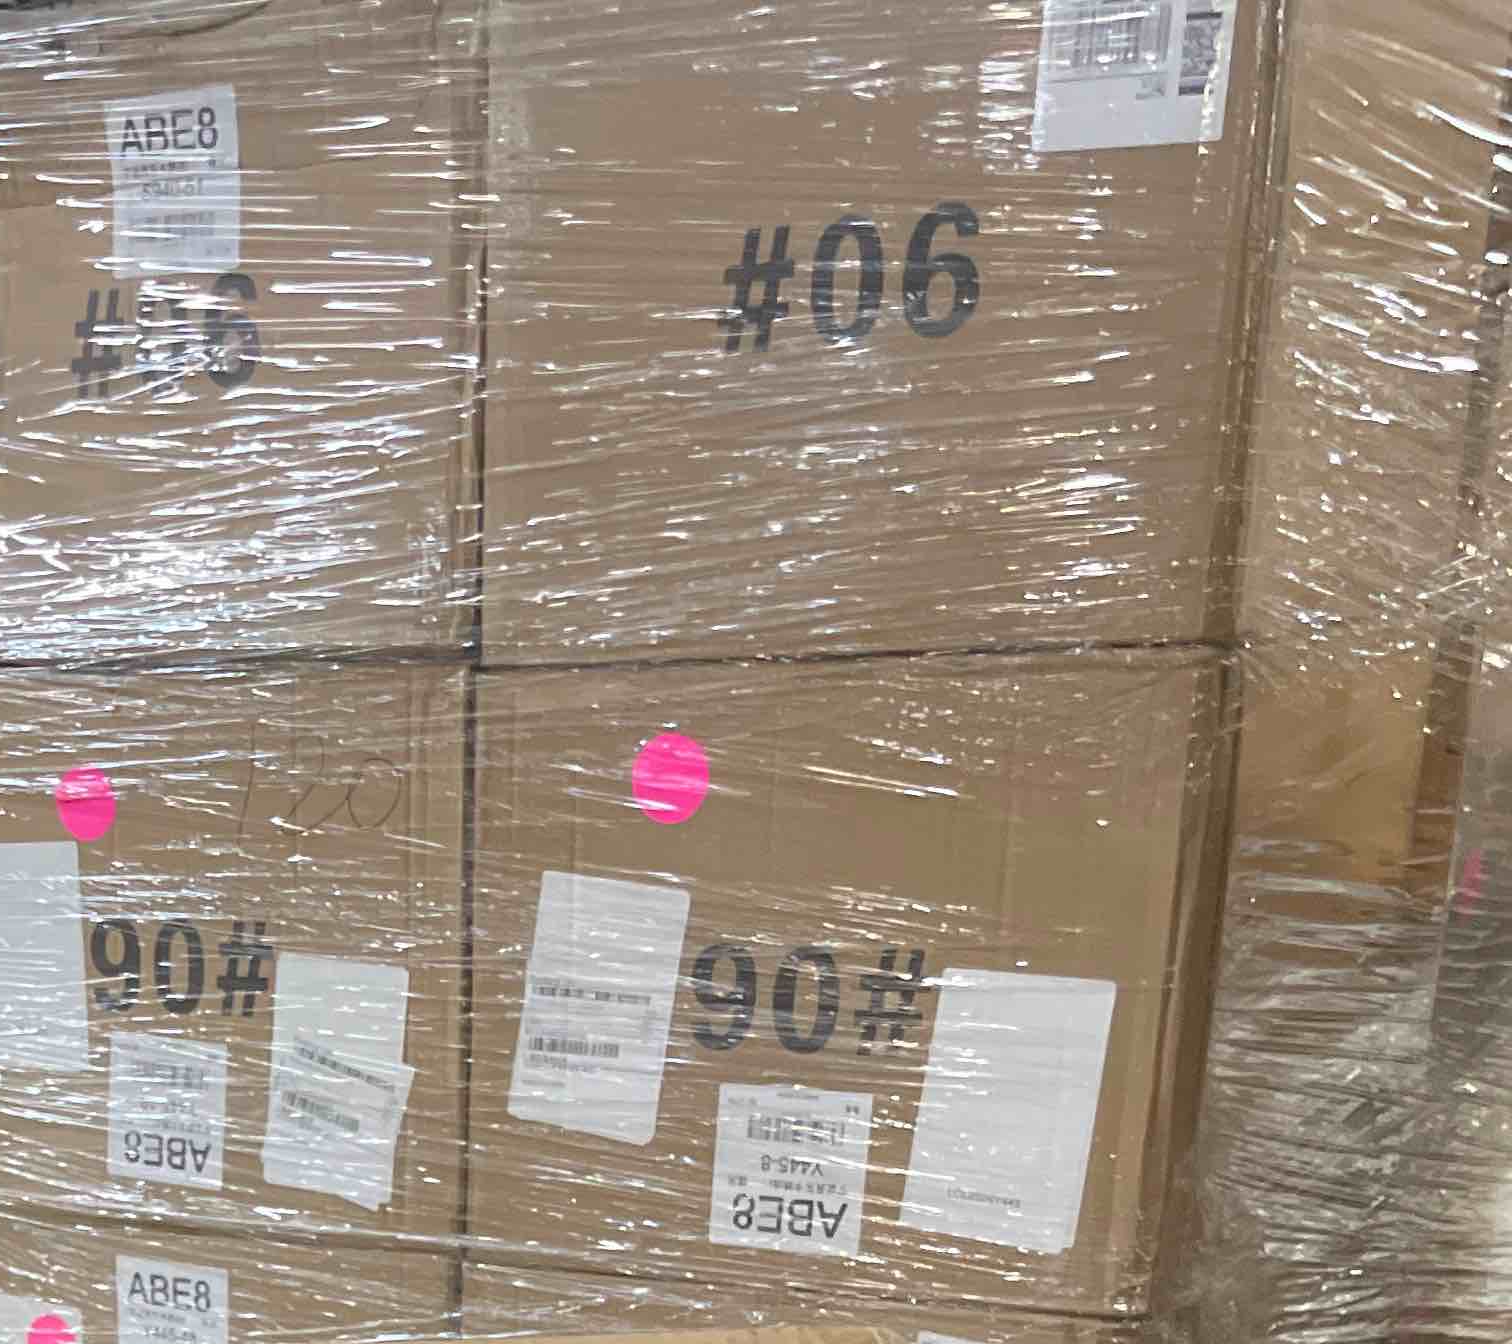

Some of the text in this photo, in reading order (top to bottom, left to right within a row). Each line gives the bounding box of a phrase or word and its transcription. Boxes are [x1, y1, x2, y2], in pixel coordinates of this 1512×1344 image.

[120, 106, 220, 156] ABE8
[716, 202, 981, 353] #06
[123, 1129, 212, 1175] ABE8
[733, 1191, 848, 1239] ABE8
[128, 1271, 212, 1313] ABE8
